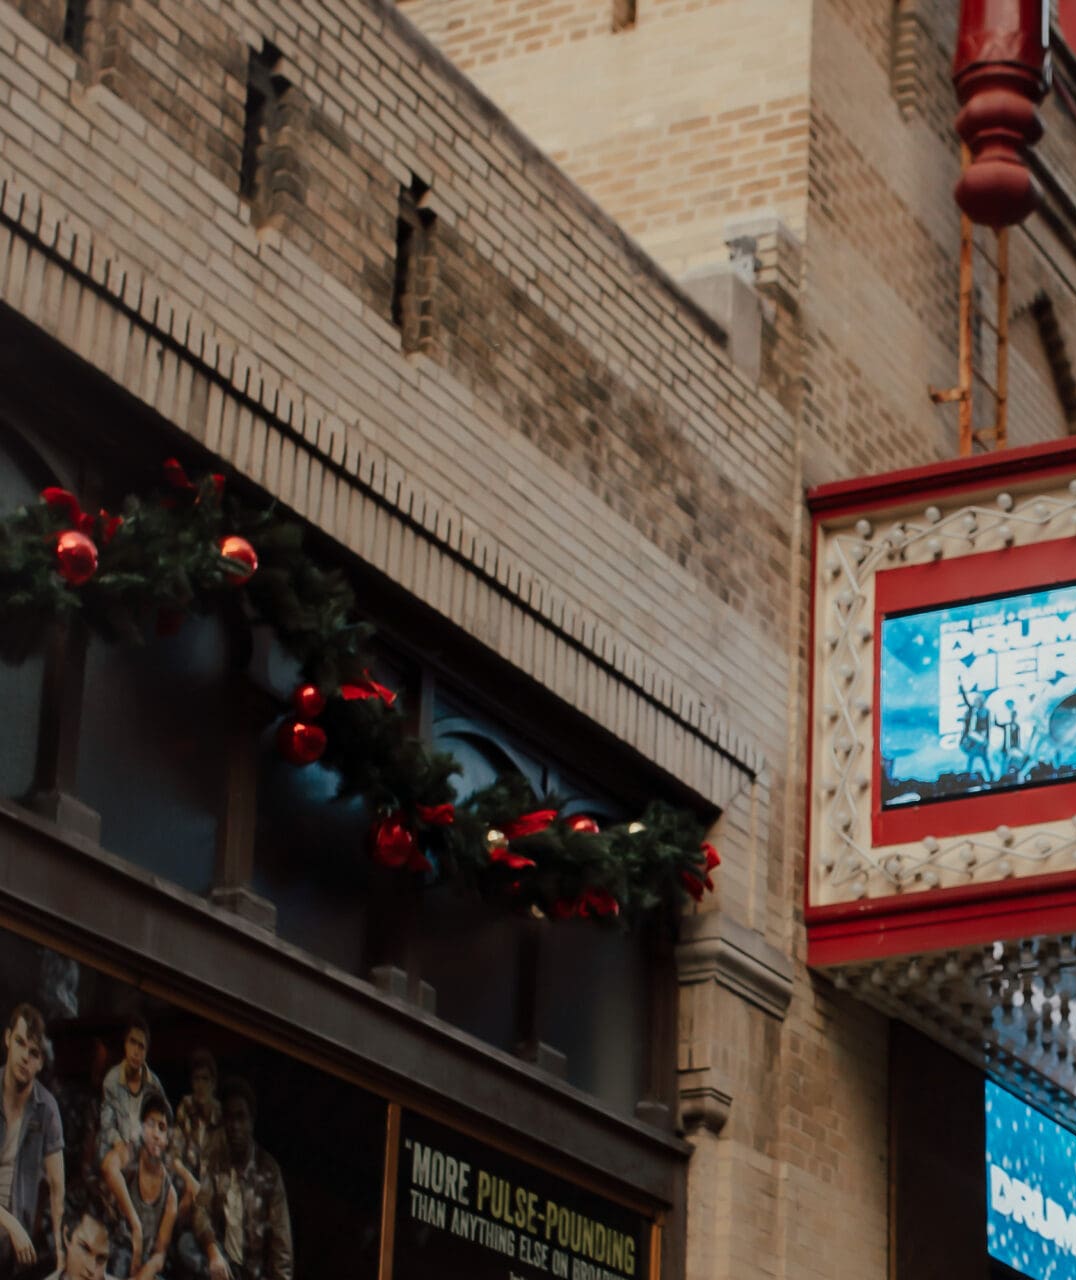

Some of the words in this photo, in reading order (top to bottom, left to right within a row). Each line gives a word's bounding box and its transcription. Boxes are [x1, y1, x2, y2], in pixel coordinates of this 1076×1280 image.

[410, 1188, 447, 1231] THAN
[451, 1207, 515, 1257] ANYTHING
[519, 1234, 550, 1271] ELSE
[552, 1249, 569, 1280] ON
[476, 1169, 636, 1276] PULSE-POUNDING
